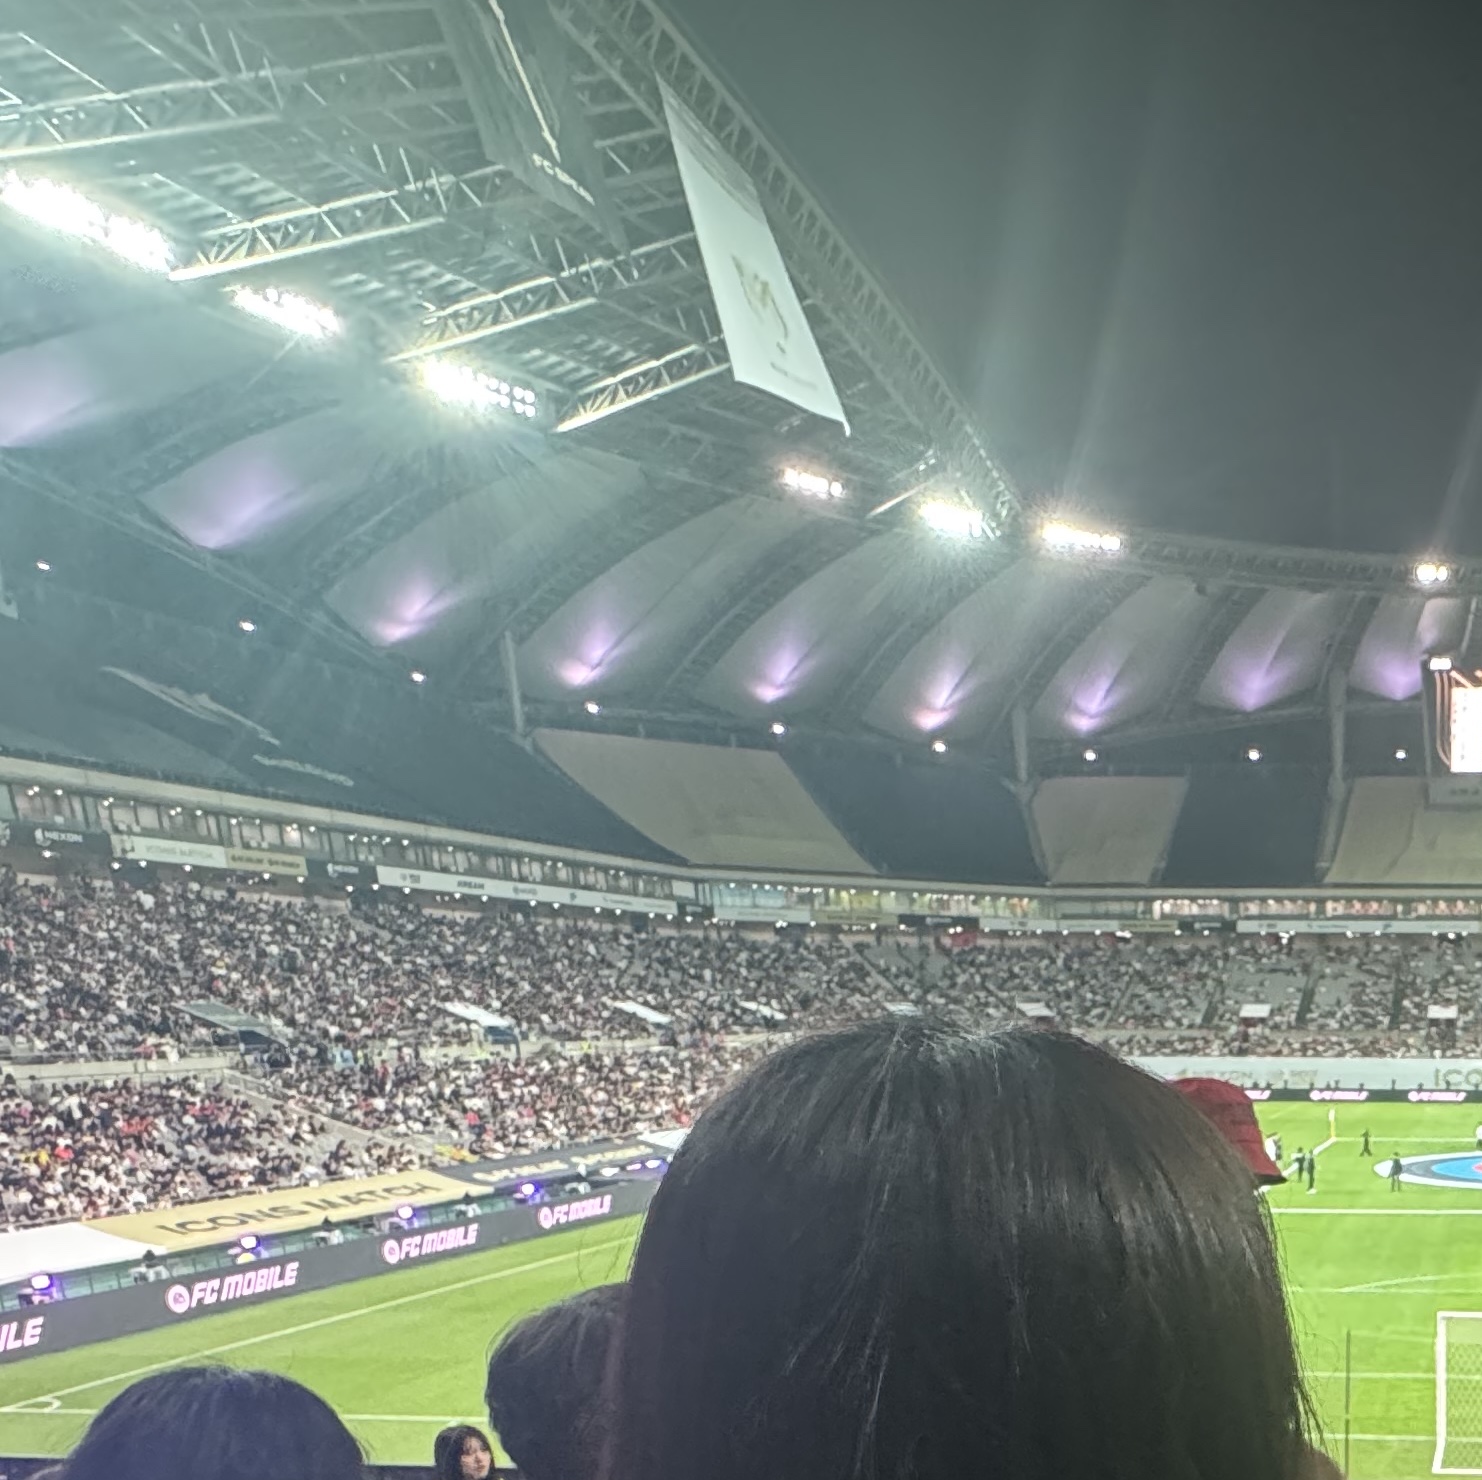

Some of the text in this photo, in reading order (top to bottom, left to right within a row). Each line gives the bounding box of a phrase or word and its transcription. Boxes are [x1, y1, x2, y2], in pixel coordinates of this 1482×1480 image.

[156, 1182, 442, 1236] ICONS MATCH
[400, 1223, 478, 1260] FC MOBILE
[190, 1261, 300, 1308] FC MOBILE
[0, 1316, 44, 1353] ILE
